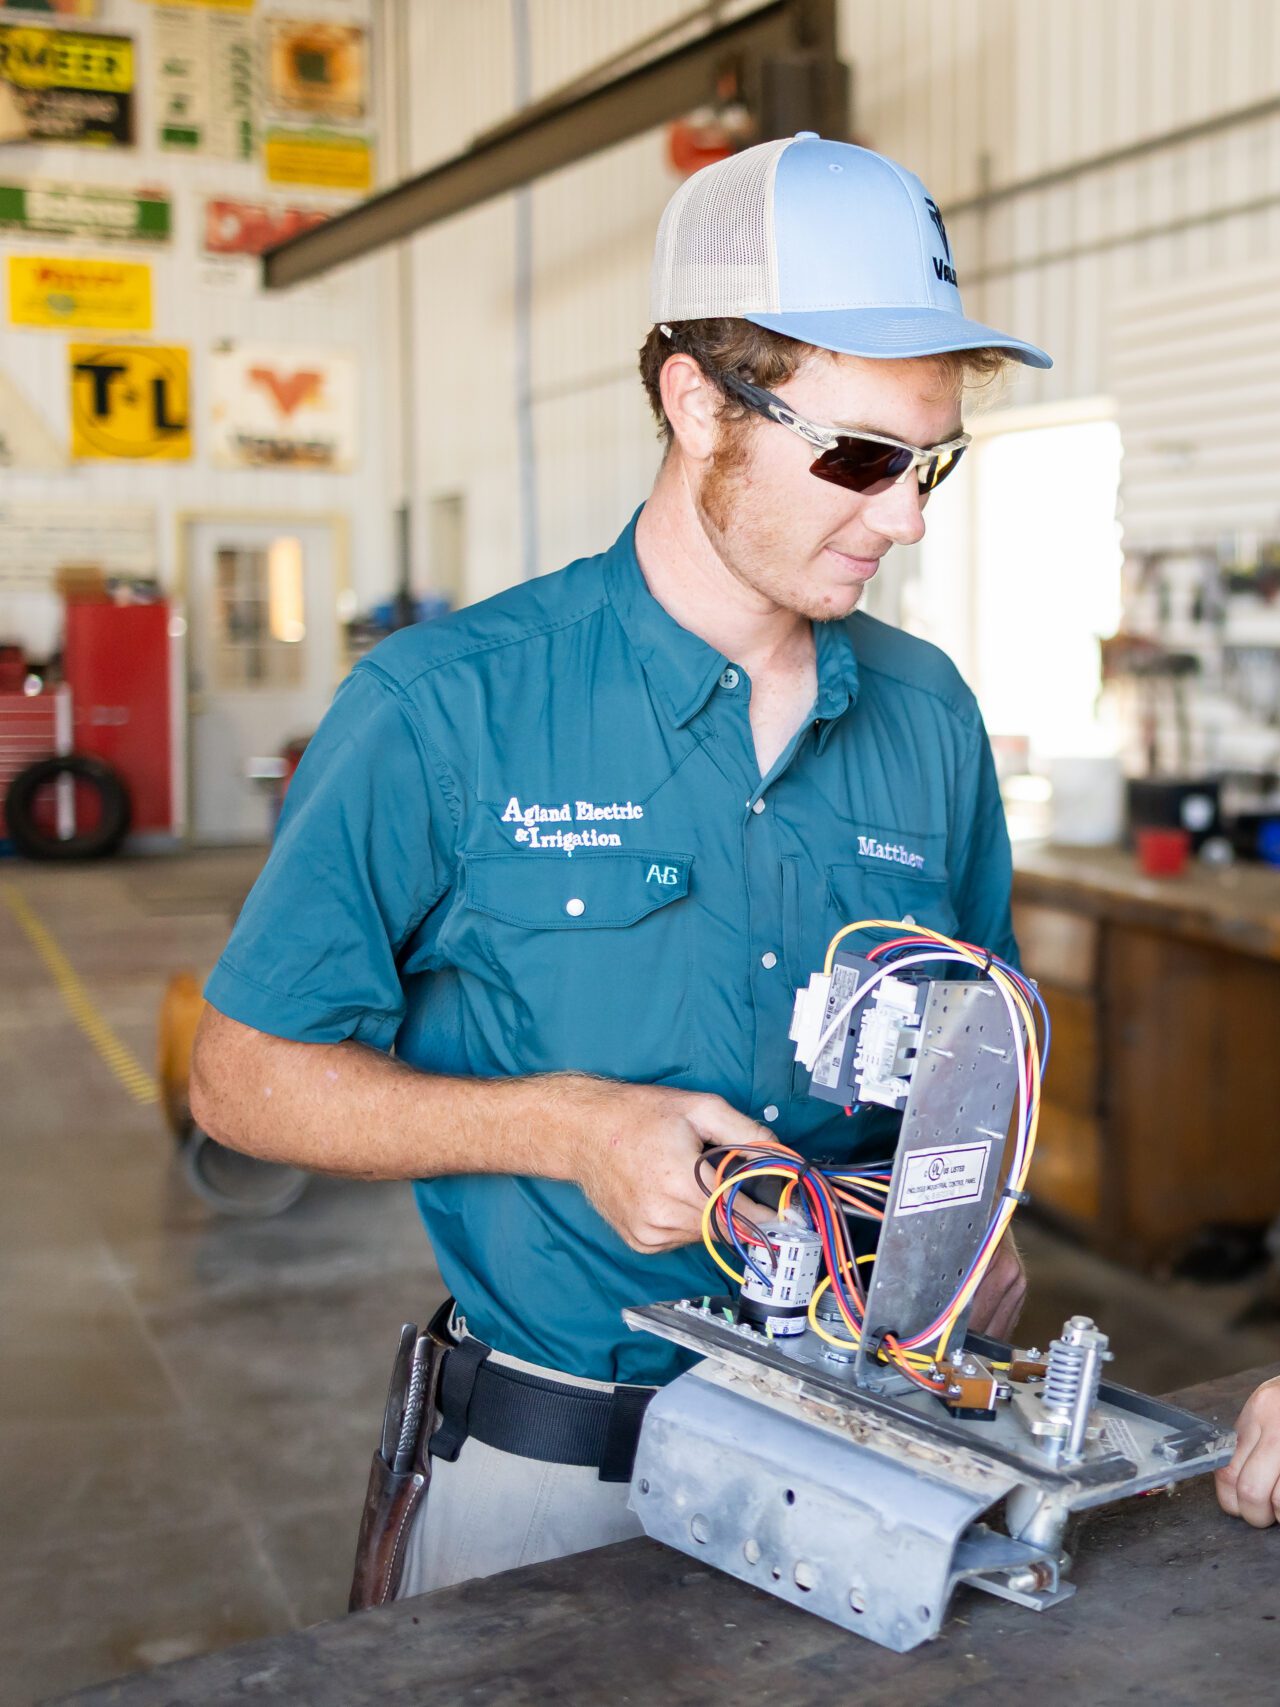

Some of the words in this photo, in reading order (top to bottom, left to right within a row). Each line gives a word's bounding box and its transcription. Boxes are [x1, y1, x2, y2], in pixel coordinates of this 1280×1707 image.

[501, 797, 572, 826] Agland
[575, 801, 644, 821] Electric
[857, 836, 925, 870] Matthew
